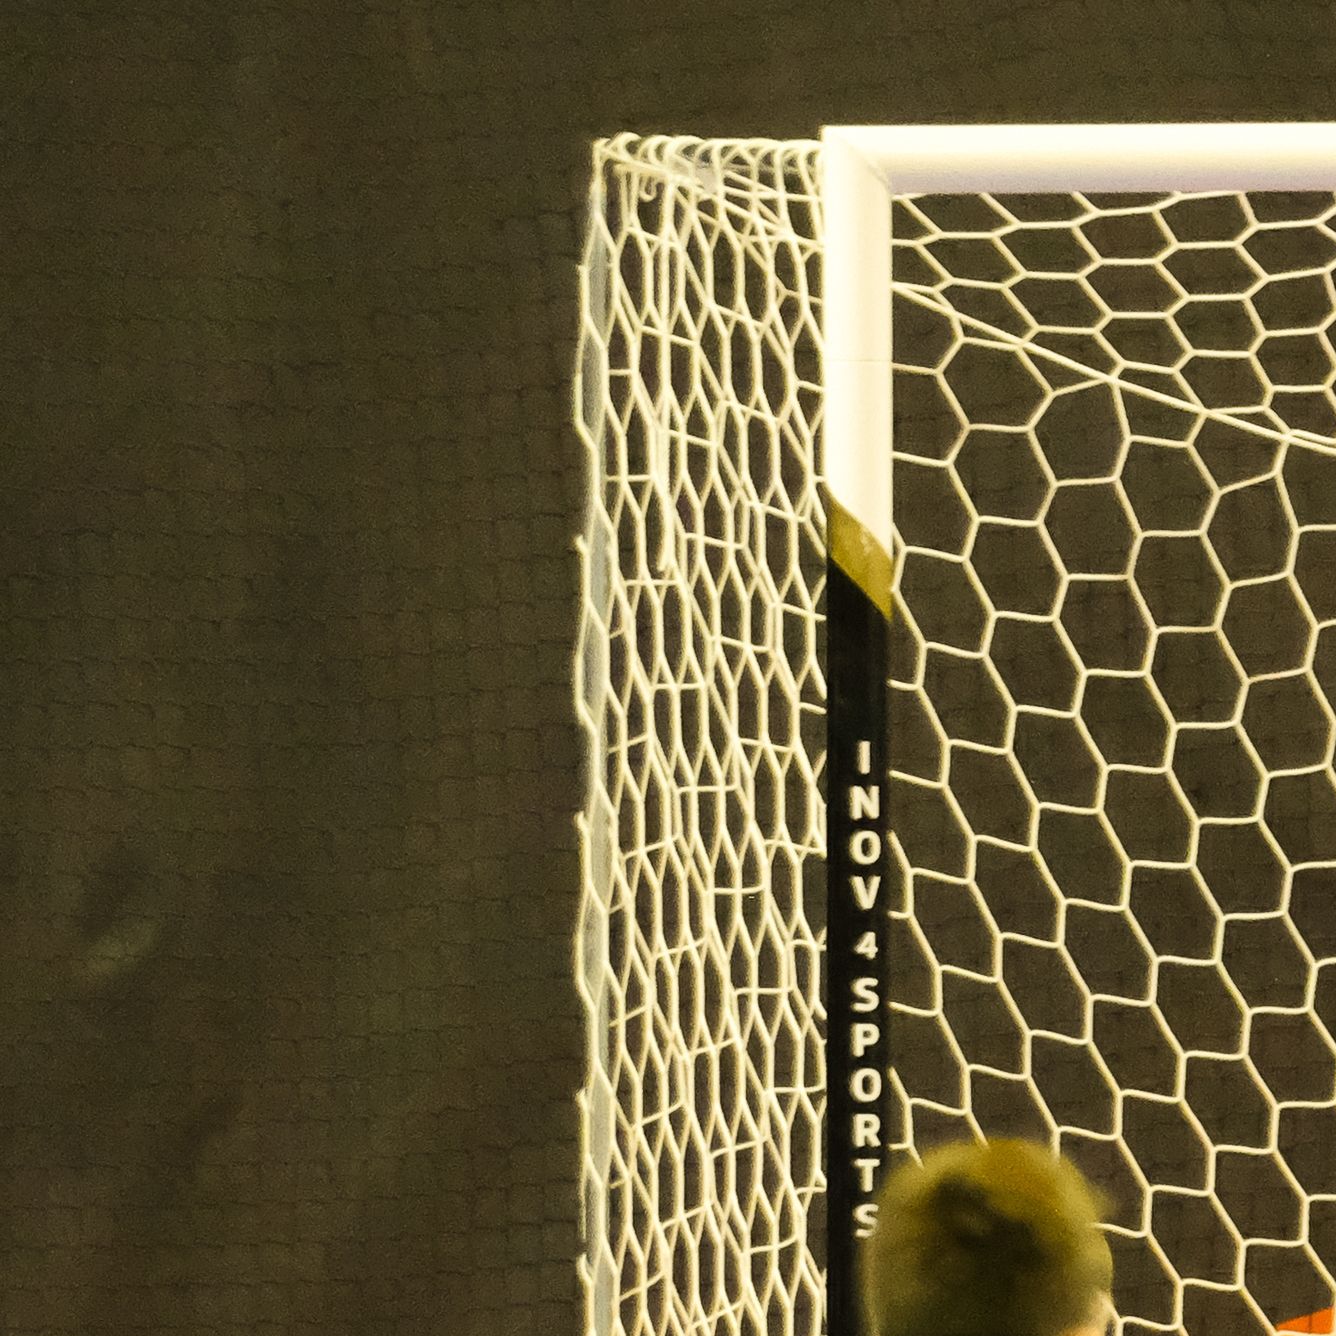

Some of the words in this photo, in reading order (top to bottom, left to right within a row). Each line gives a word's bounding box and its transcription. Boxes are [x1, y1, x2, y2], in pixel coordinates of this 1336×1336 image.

[848, 740, 882, 911] INOV
[854, 930, 879, 960] 4
[848, 976, 882, 1239] SPORTS
